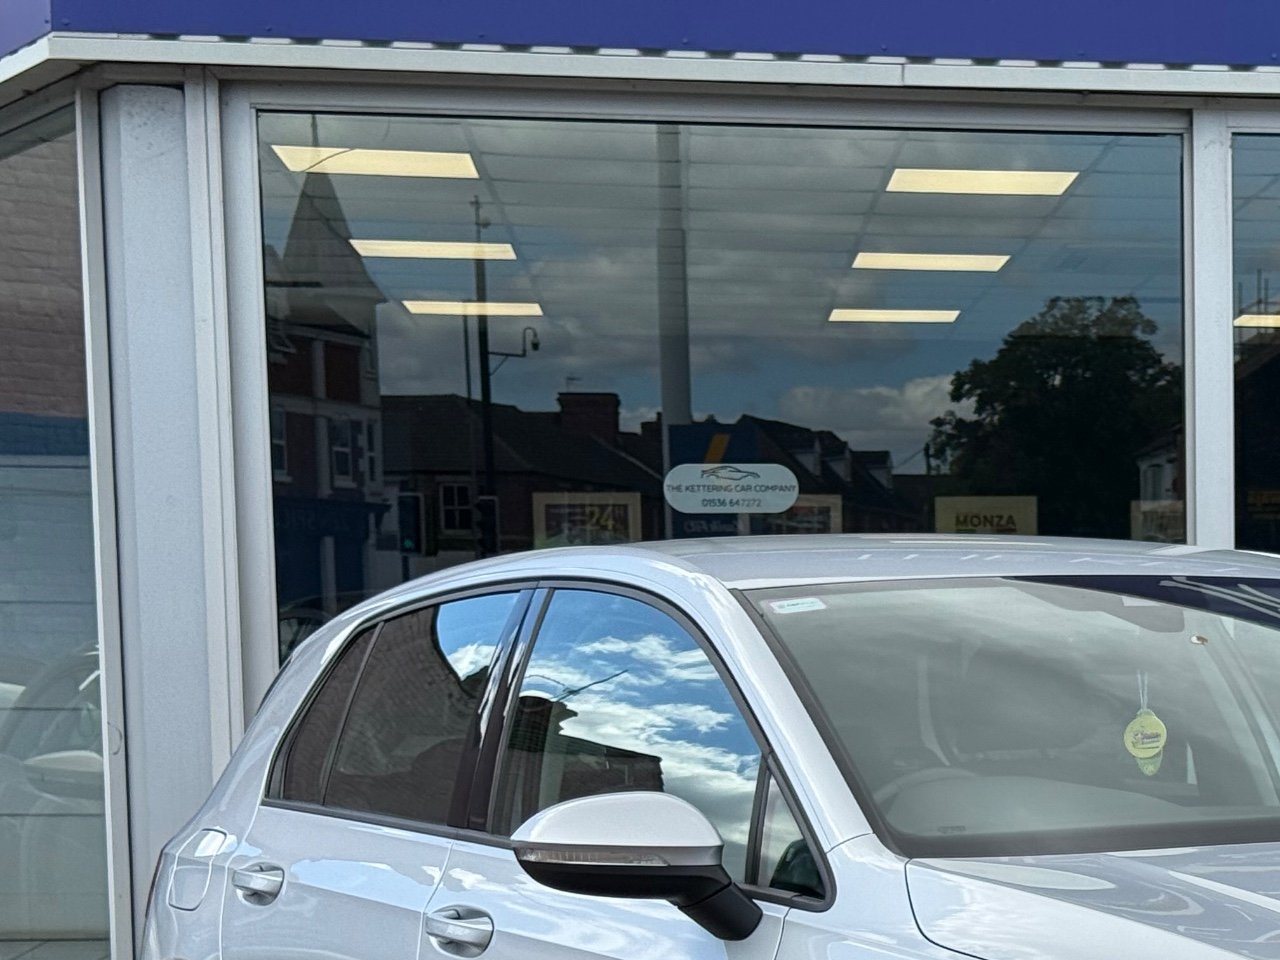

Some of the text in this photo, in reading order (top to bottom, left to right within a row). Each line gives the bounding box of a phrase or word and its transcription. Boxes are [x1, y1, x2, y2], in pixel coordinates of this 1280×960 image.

[666, 484, 797, 493] THE KETTERING CAR COMPANY
[955, 514, 1017, 528] MONZA
